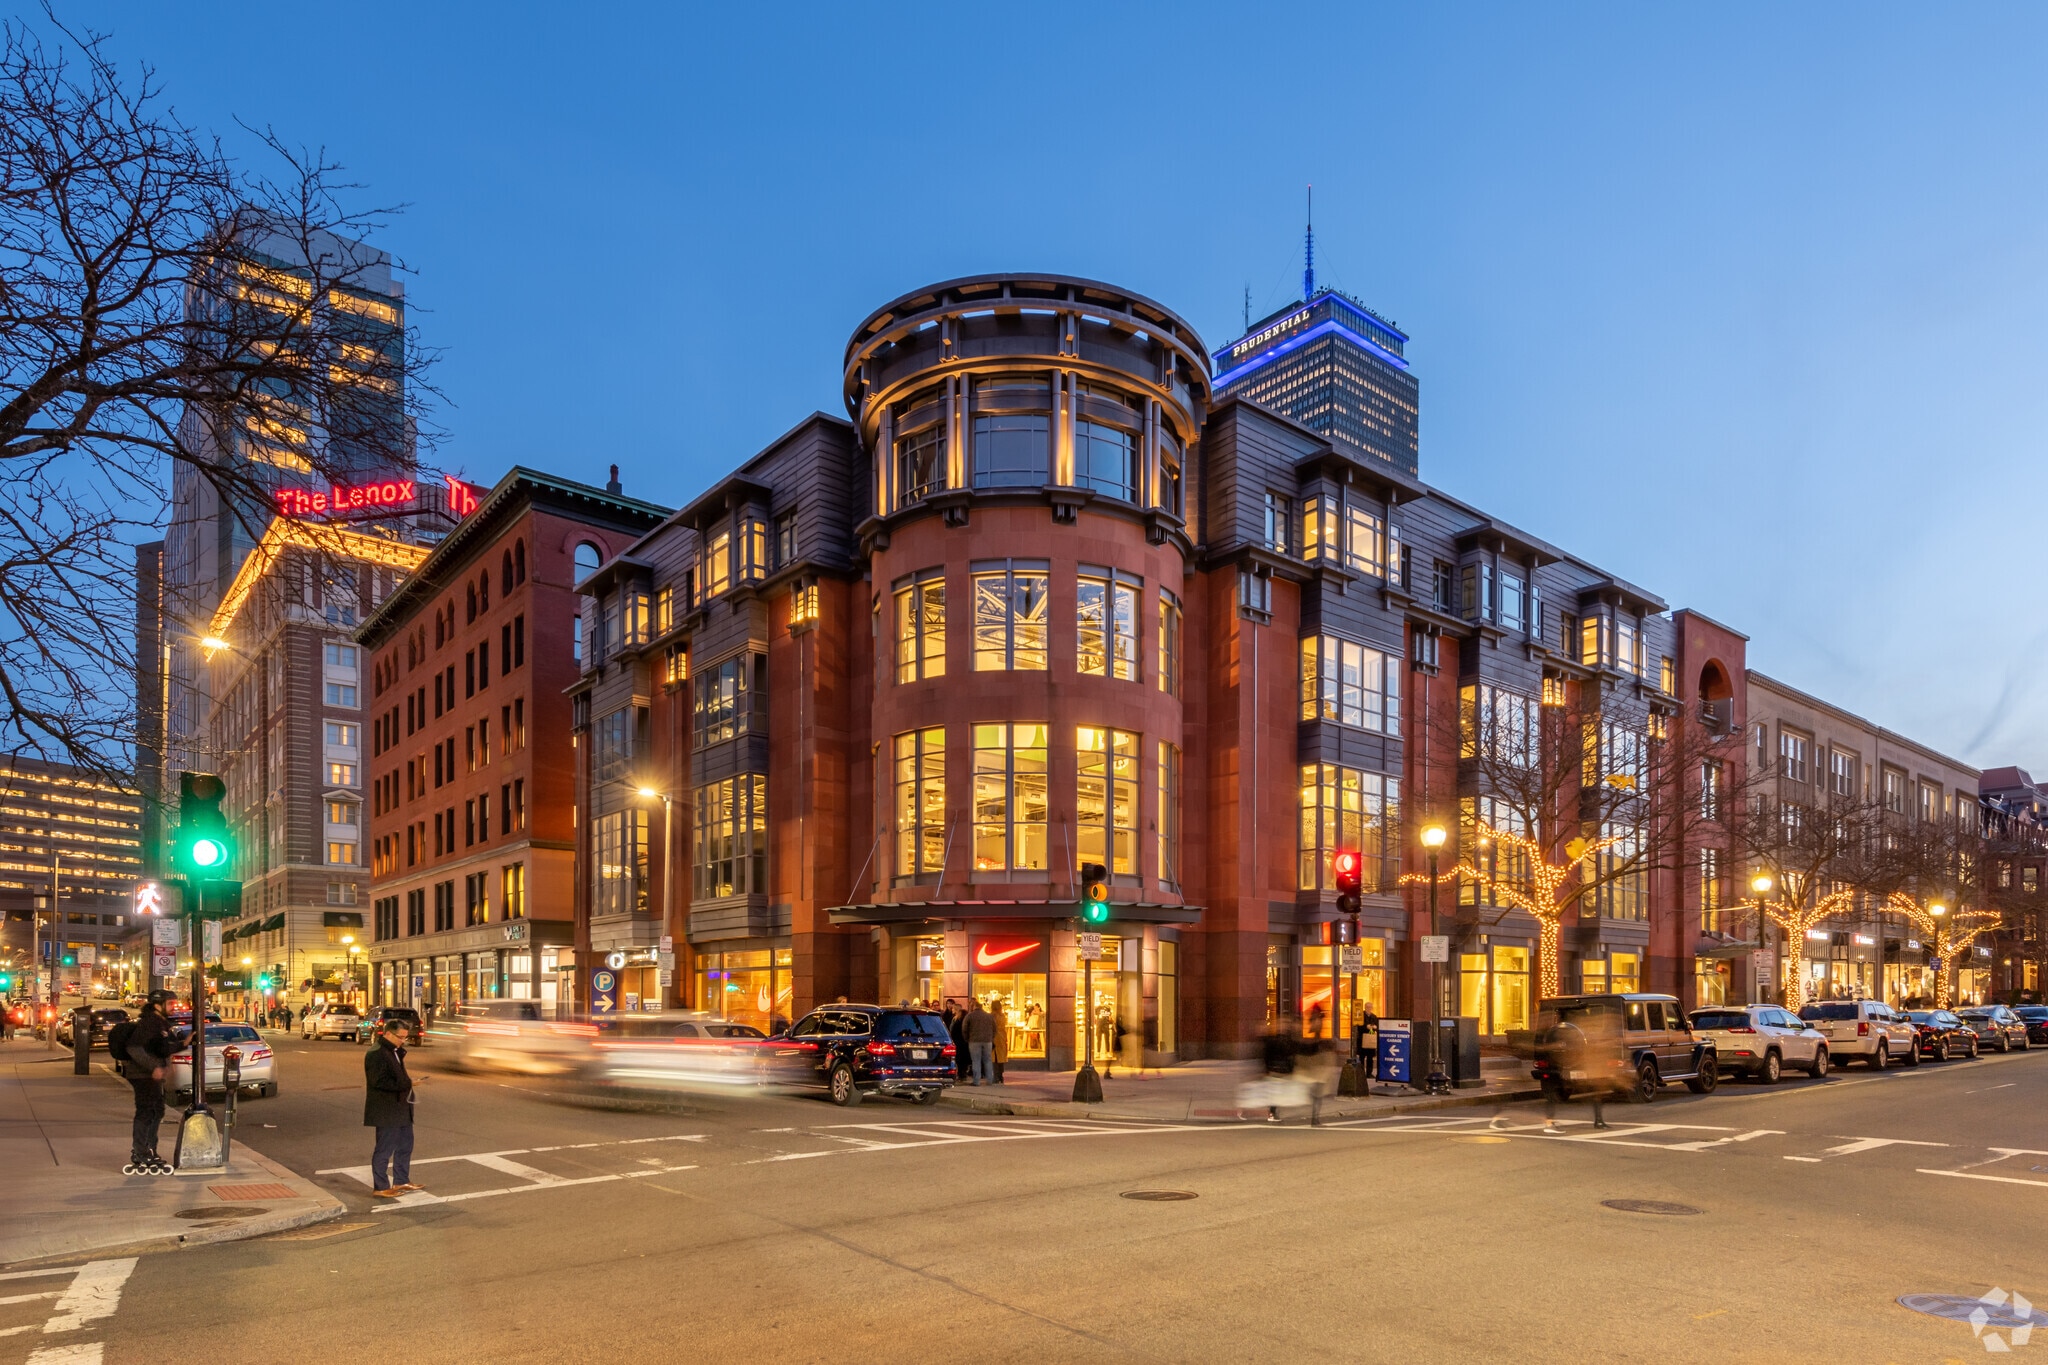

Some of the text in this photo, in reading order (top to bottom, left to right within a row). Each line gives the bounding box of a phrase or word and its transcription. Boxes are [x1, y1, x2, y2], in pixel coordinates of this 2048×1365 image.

[1233, 309, 1310, 357] PRUDENTIAL
[276, 481, 415, 515] The Lenox
[444, 475, 479, 516] Th
[1083, 934, 1100, 943] YIELD
[1343, 948, 1361, 956] YIELD
[600, 975, 611, 989] P
